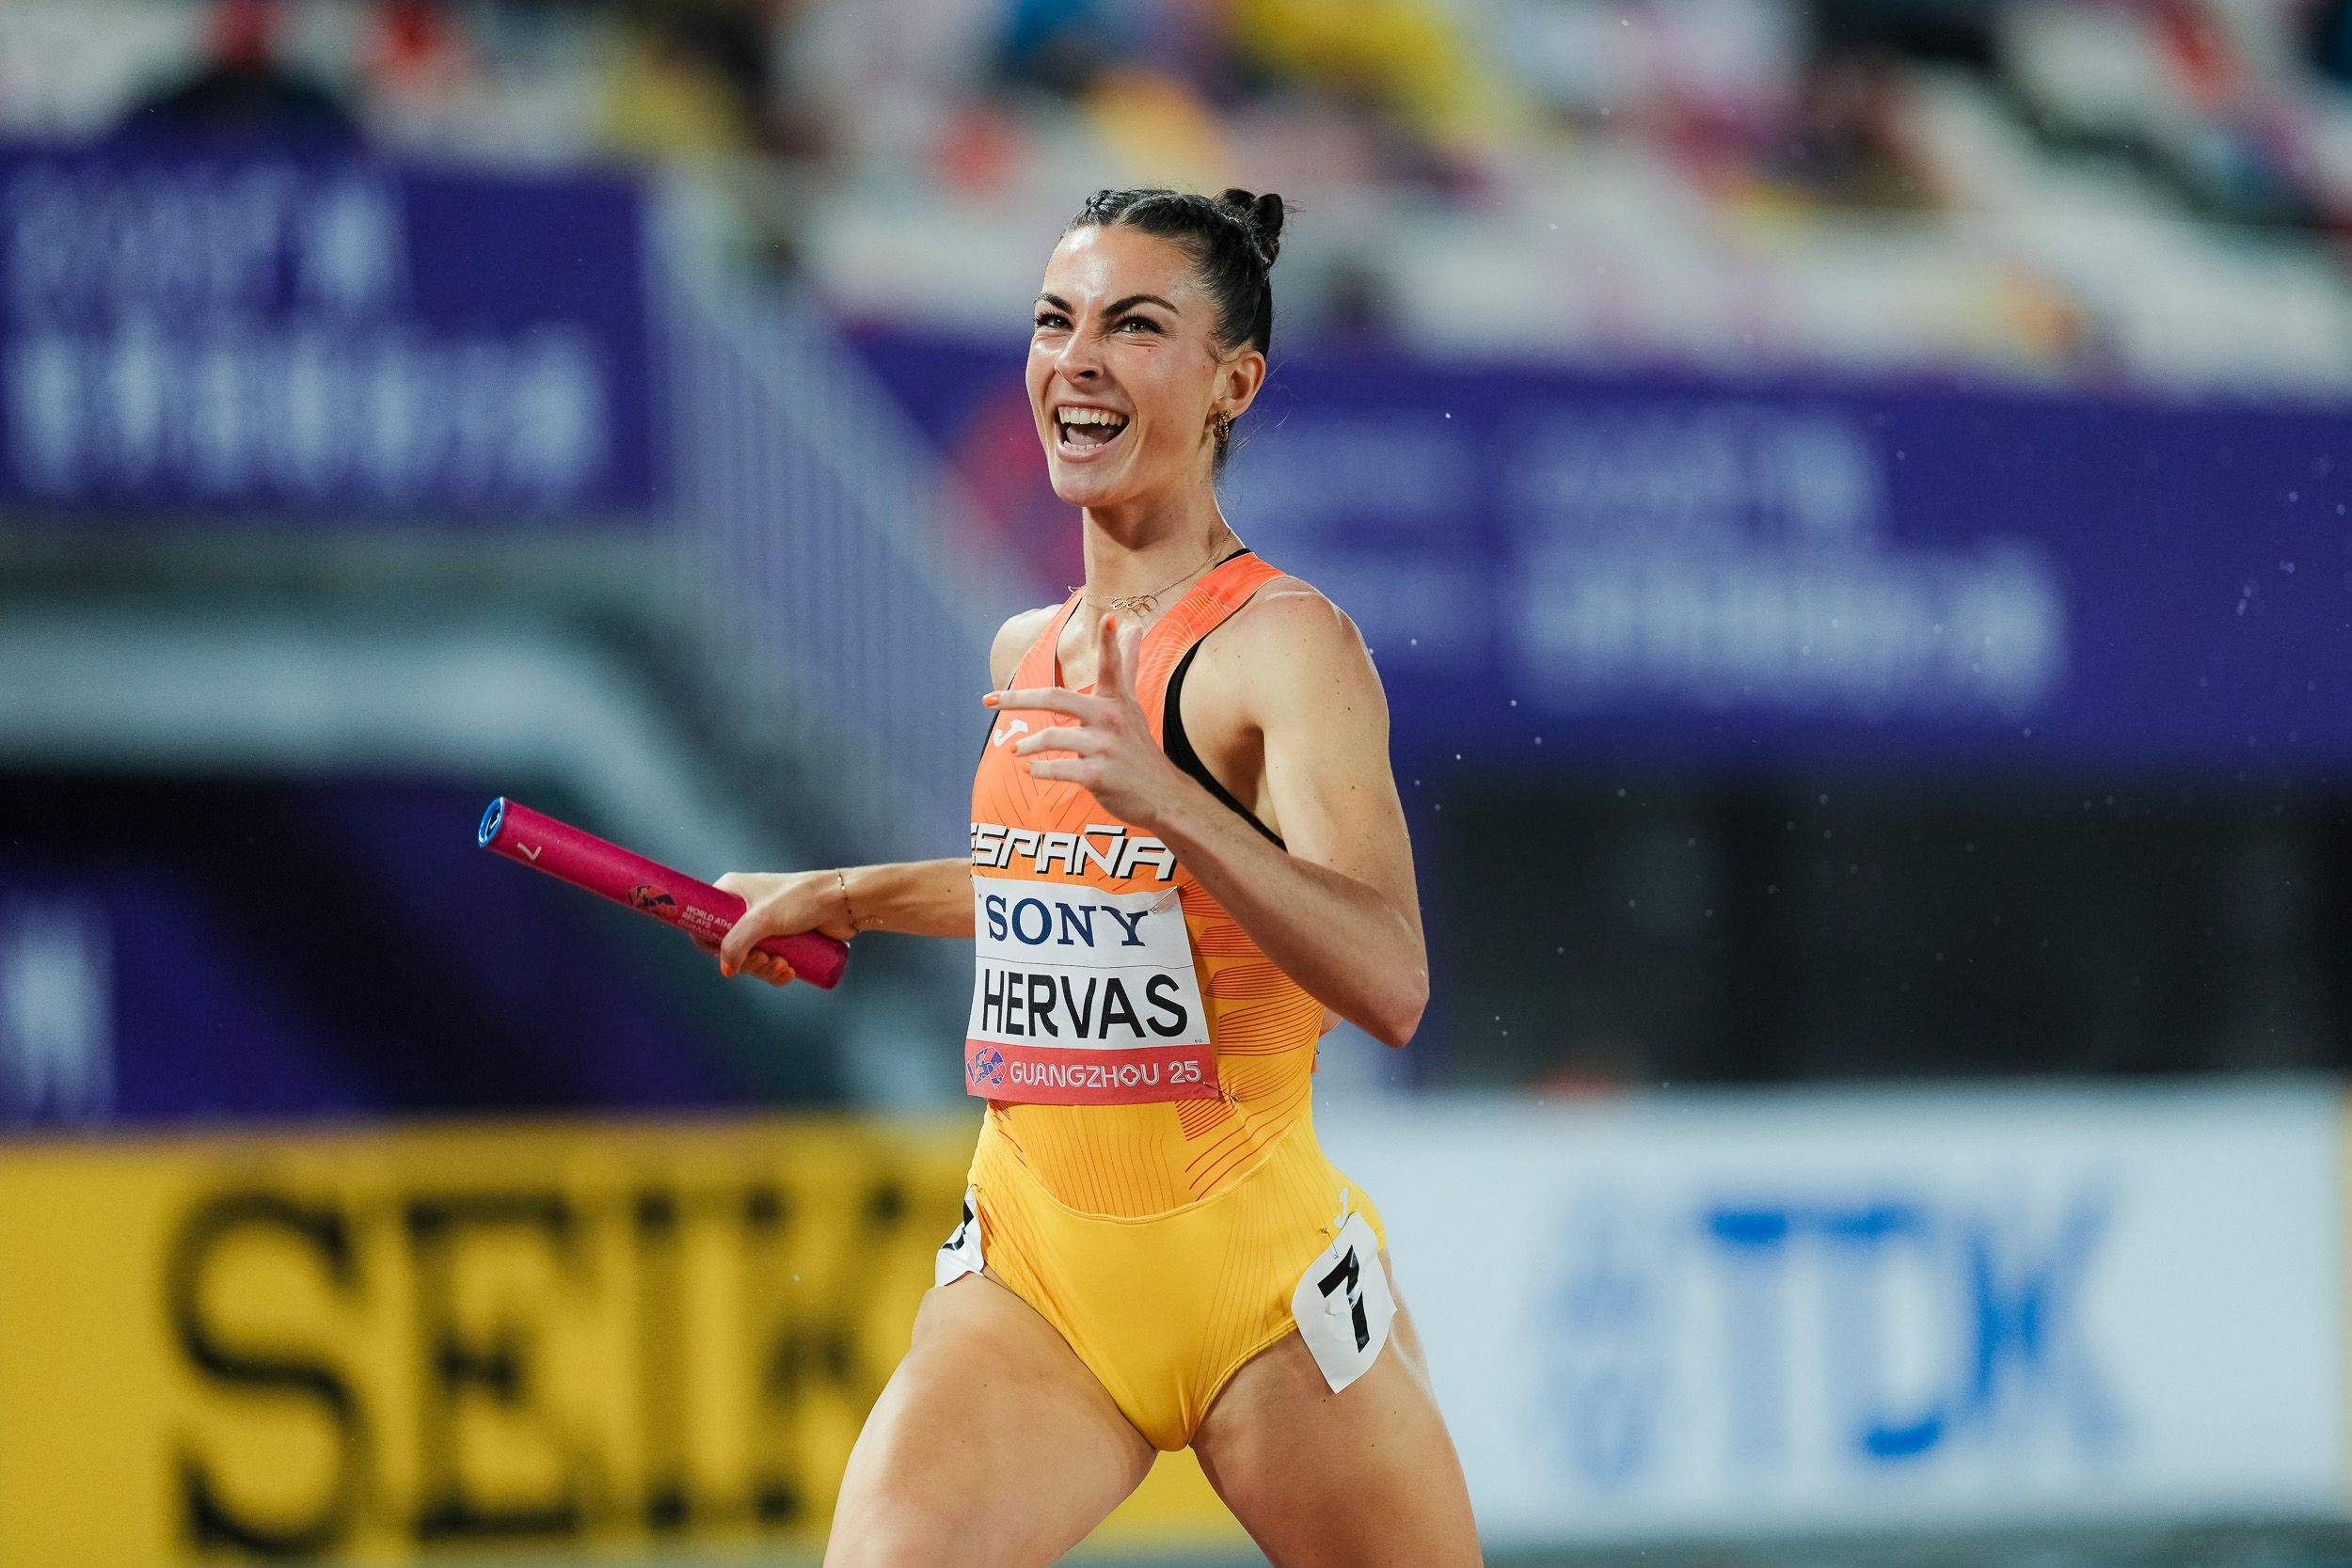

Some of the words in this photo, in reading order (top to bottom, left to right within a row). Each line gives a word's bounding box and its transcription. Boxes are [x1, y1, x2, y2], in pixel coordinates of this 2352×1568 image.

[517, 842, 542, 861] 7
[971, 822, 1178, 882] SPAÑA
[681, 911, 710, 929] RELAYS
[686, 905, 714, 922] WORLD
[985, 894, 1149, 947] SONY
[981, 968, 1188, 1039] HERVAS
[1009, 1061, 1160, 1088] GUANGZHOU
[1168, 1060, 1202, 1084] 25
[1317, 1244, 1371, 1354] 7
[166, 1187, 927, 1560] SEIK
